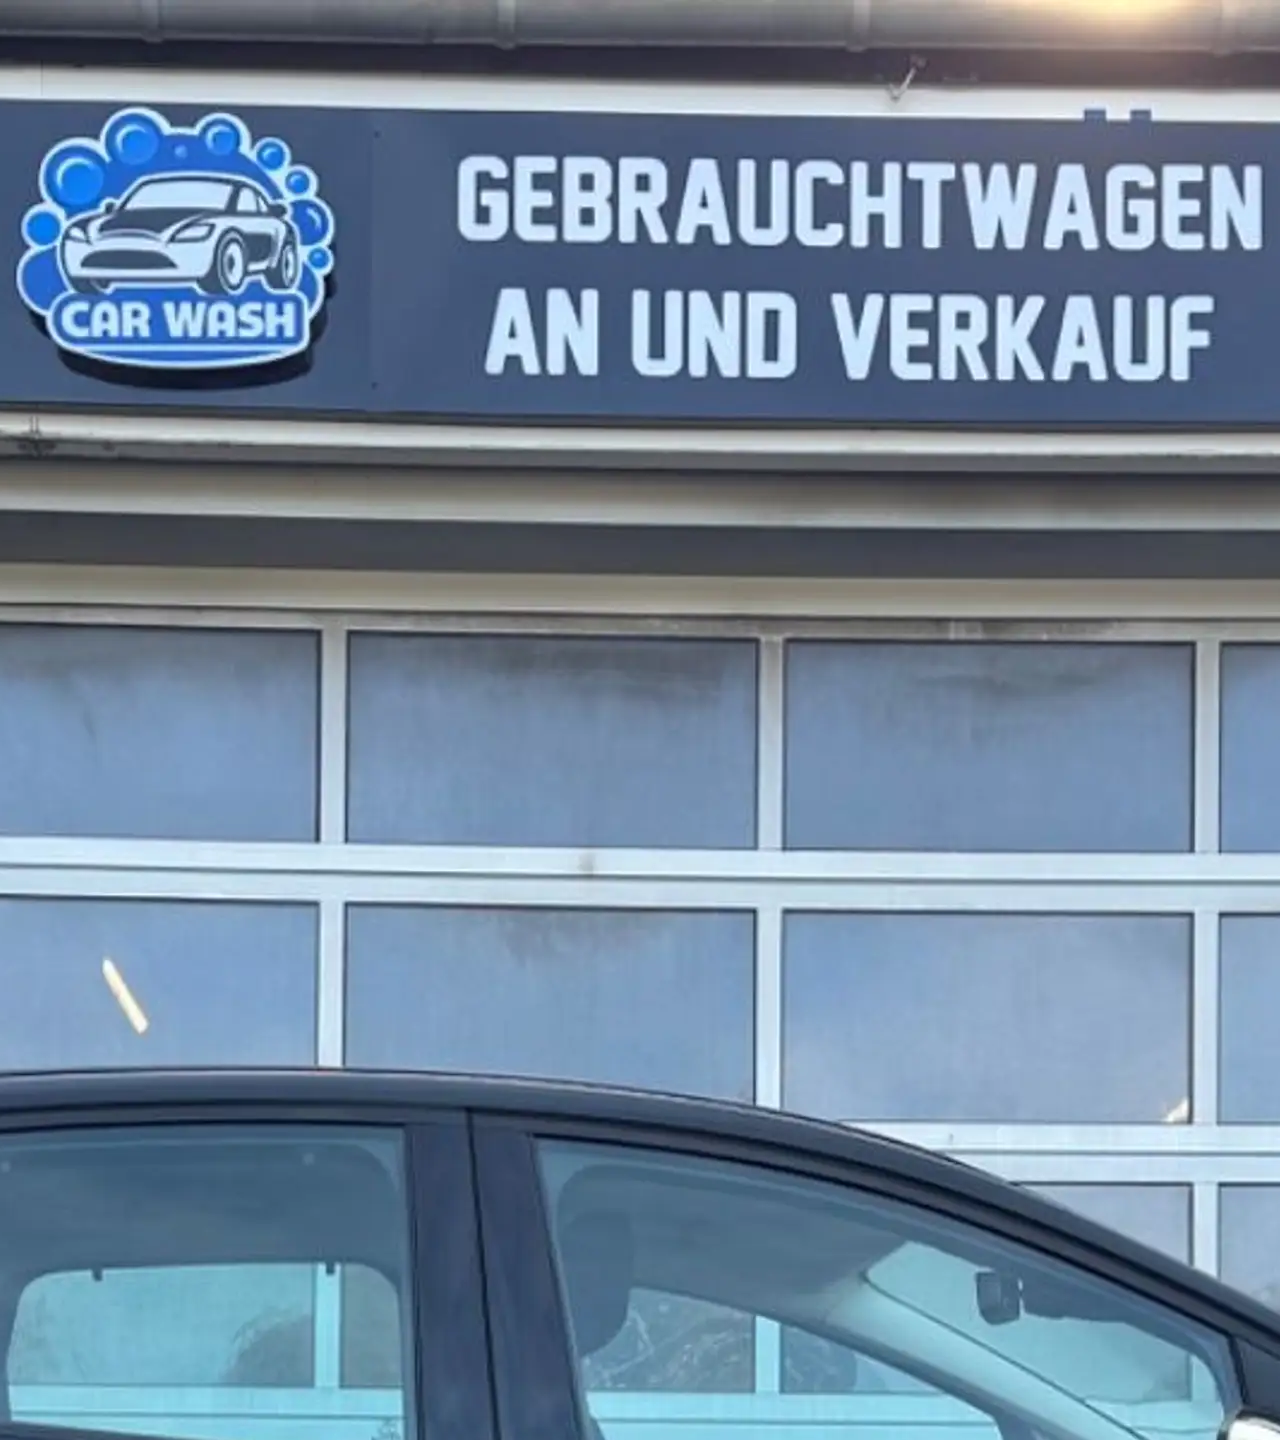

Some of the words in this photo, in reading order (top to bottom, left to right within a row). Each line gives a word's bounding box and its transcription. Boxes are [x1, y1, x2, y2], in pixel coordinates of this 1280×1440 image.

[61, 301, 150, 338] CAR
[163, 302, 295, 338] WASH
[484, 288, 600, 376] AN
[632, 289, 797, 378] UND
[831, 293, 1214, 382] VERKAUF
